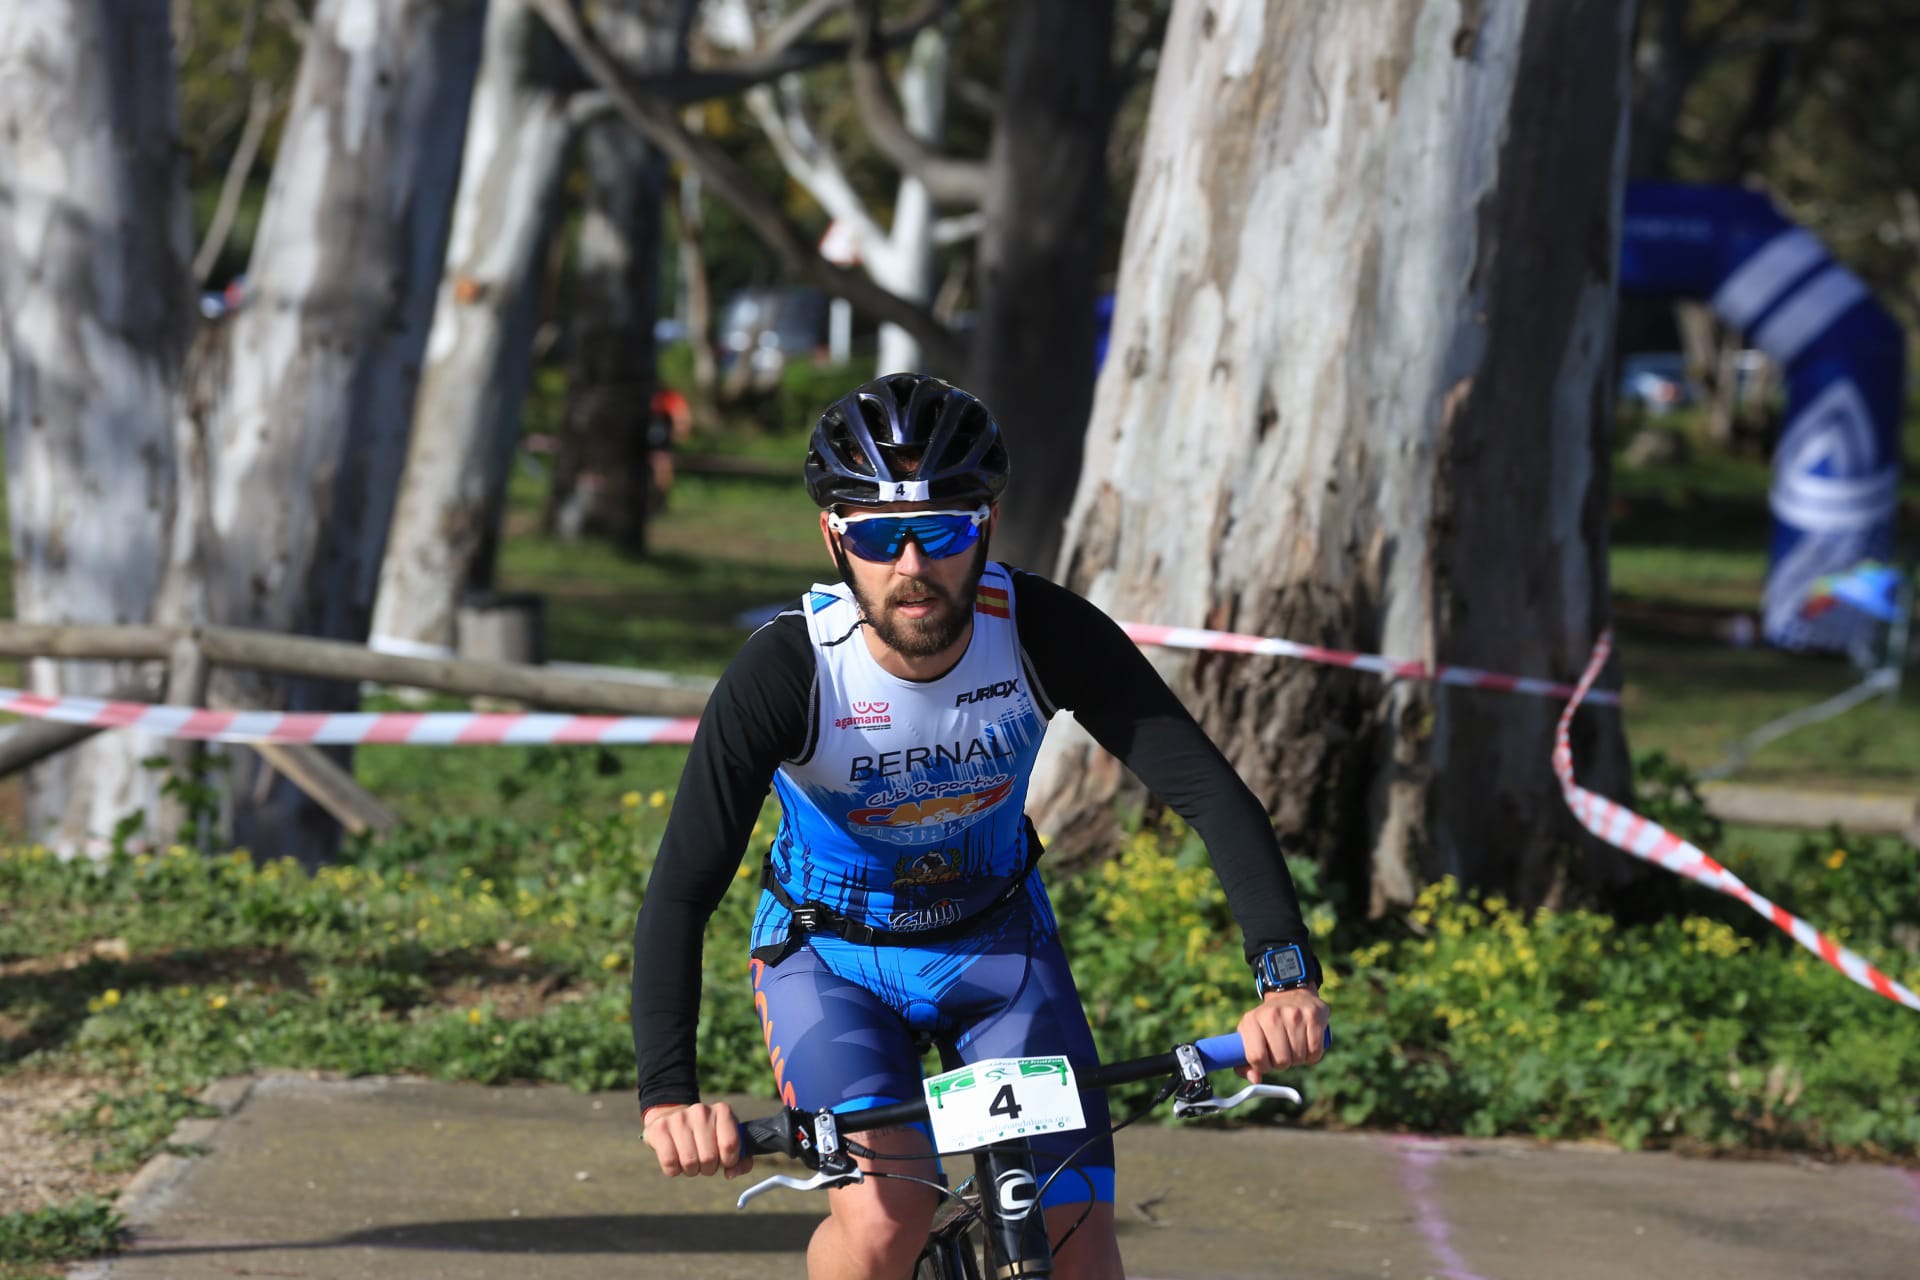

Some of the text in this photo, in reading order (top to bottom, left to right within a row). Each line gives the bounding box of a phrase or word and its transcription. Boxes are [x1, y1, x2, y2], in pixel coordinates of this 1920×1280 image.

[895, 483, 906, 496] 4
[955, 678, 1020, 708] FURIOX
[834, 714, 892, 730] agamama
[849, 735, 1014, 782] BERNAL
[867, 774, 1007, 807] Club Deportivo
[988, 1083, 1023, 1120] 4
